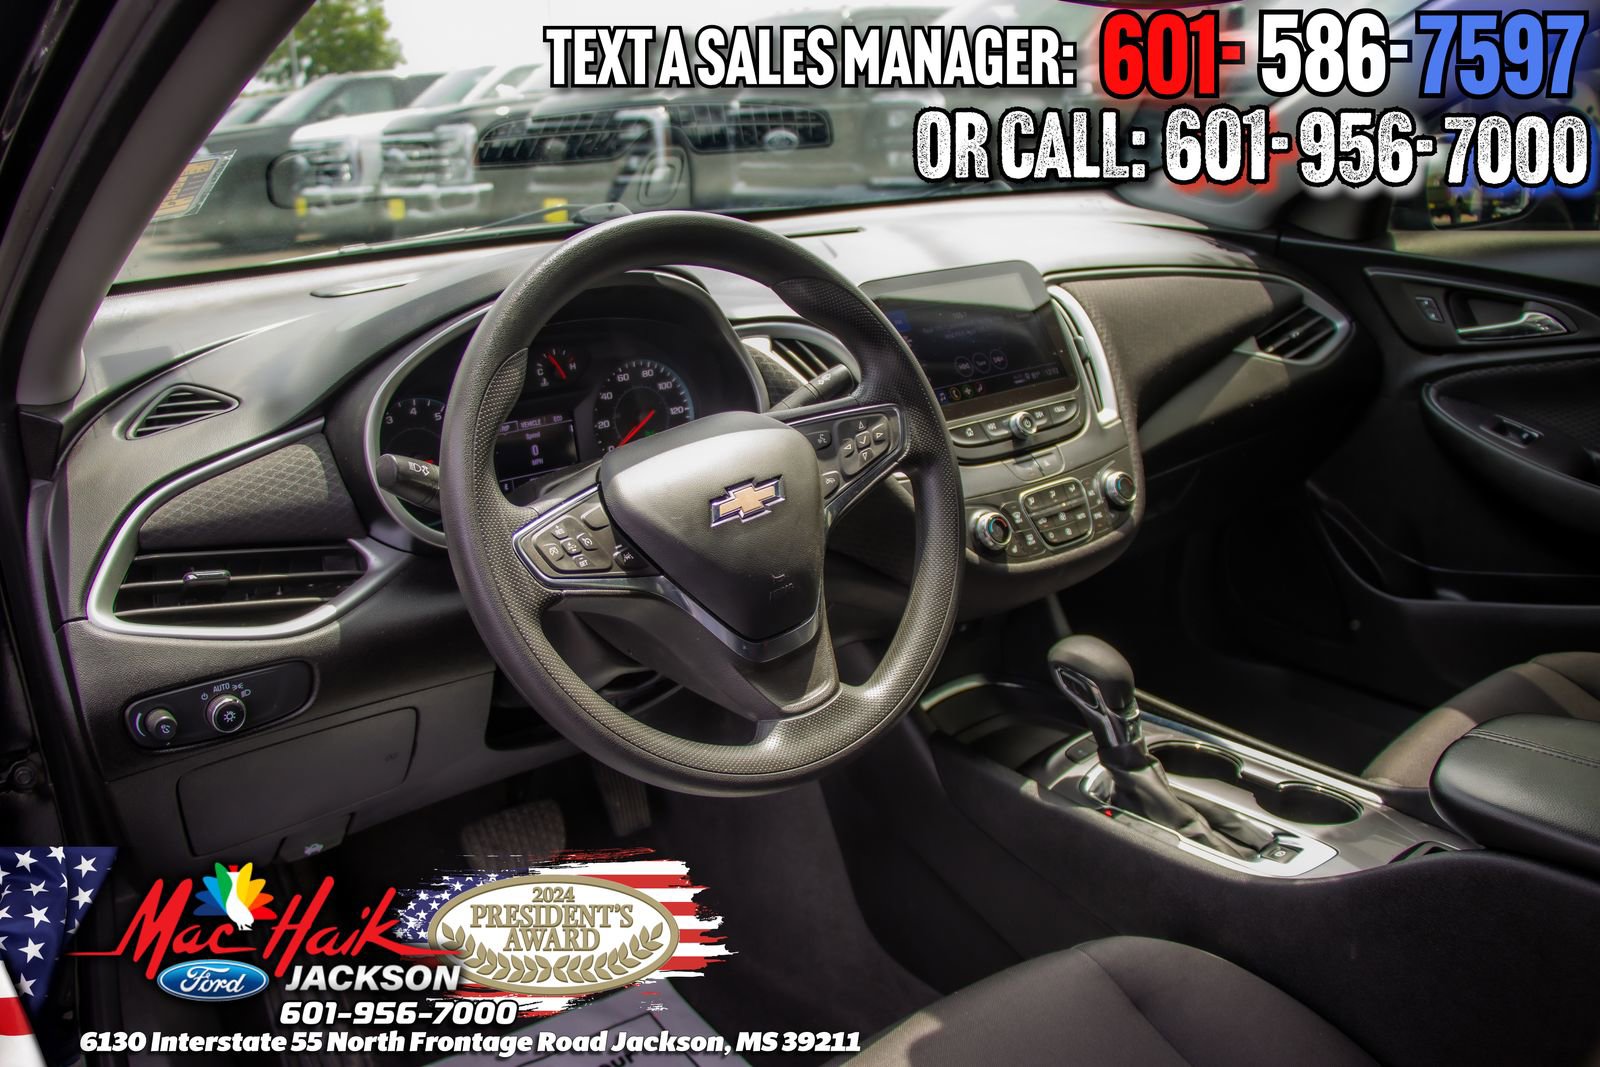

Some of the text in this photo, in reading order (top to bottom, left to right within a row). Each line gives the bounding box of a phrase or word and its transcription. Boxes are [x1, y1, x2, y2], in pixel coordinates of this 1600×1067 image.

[616, 373, 630, 382] 60
[642, 369, 654, 378] 80
[658, 381, 673, 390] 100
[601, 391, 613, 400] 40
[410, 407, 417, 415] 4
[670, 406, 684, 415] 120
[385, 415, 394, 424] 3
[434, 412, 442, 421] 5
[598, 420, 610, 429] 20
[531, 444, 540, 456] 0
[212, 682, 230, 693] AUTO
